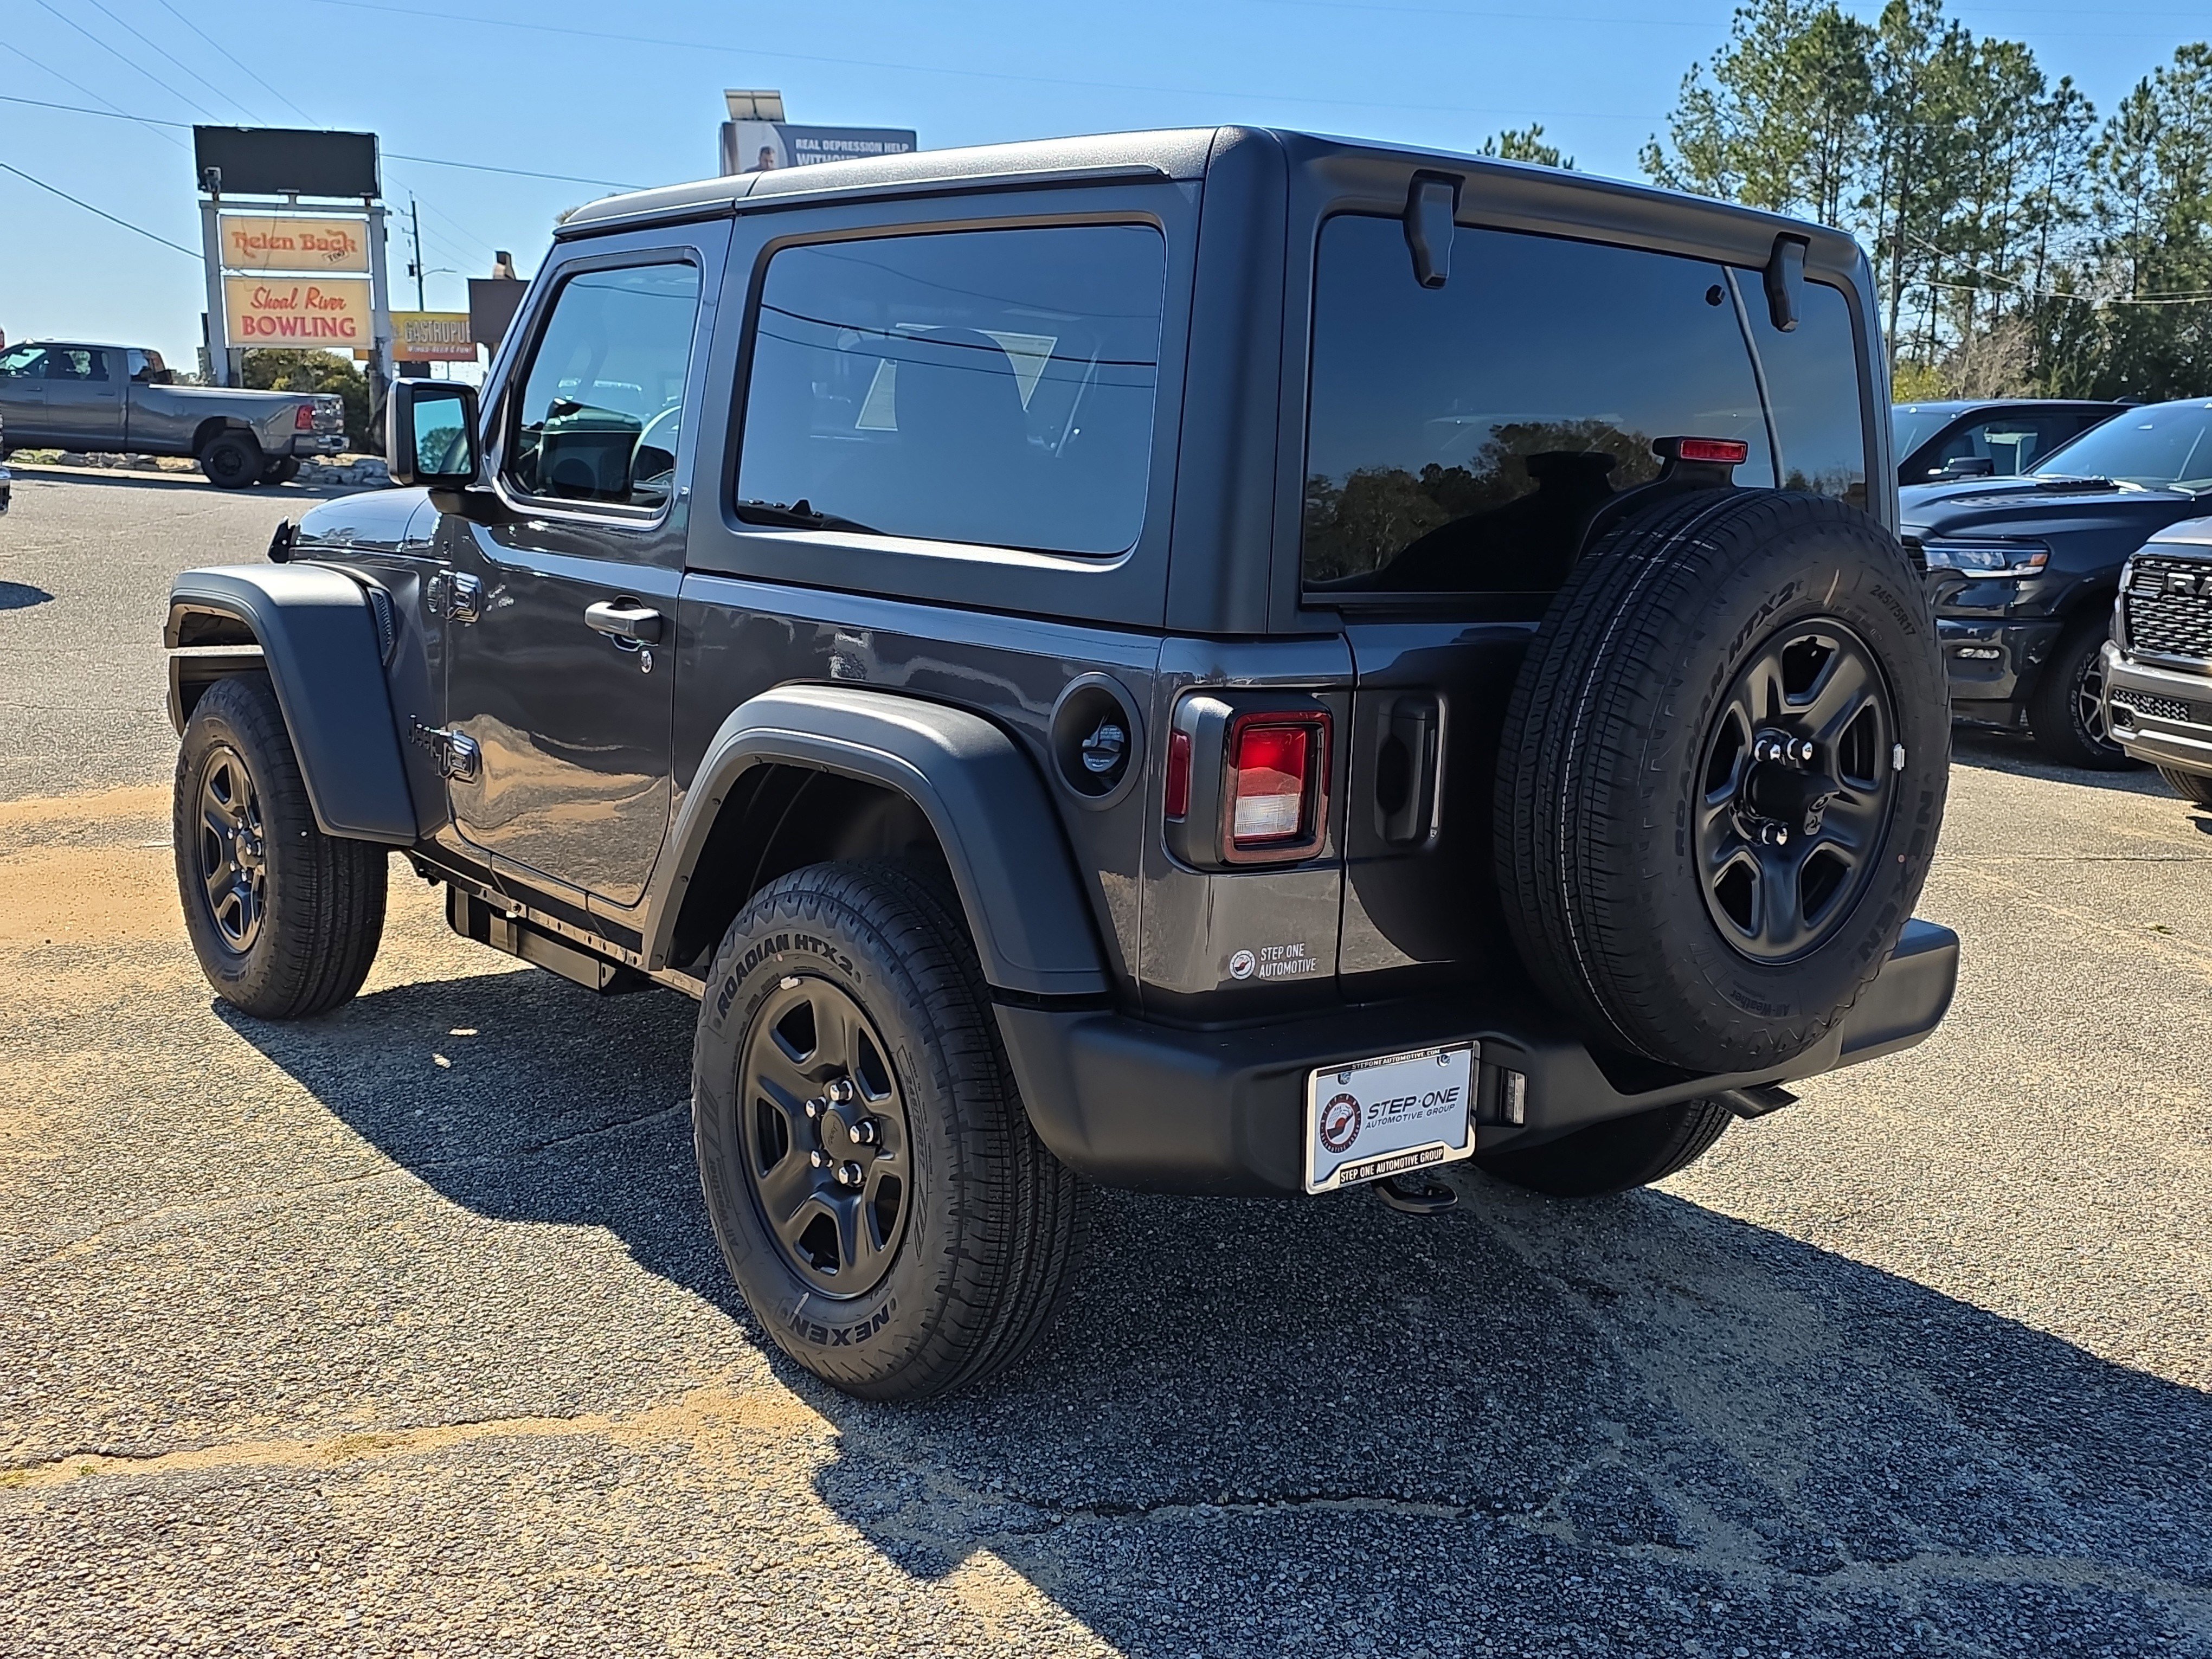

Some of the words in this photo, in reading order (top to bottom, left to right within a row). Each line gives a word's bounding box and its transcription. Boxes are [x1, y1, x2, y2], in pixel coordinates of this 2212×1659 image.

[795, 138, 820, 150] REAL
[822, 139, 883, 153] DEPRESSION
[884, 142, 909, 153] HELP
[796, 153, 858, 165] WITH
[299, 229, 358, 253] Back
[250, 286, 298, 311] Shoal
[305, 287, 346, 311] River
[242, 315, 357, 338] BOWLING
[1869, 584, 1917, 636] 245/75R17
[1260, 946, 1284, 961] STEP
[1286, 943, 1305, 958] ONE
[716, 934, 789, 1020] ROADIAN
[794, 934, 854, 977] HTX2
[1258, 957, 1317, 978] AUTOMOTIVE
[1365, 1110, 1423, 1130] AUTOMOTIVE
[1426, 1103, 1456, 1117] GROUP
[1341, 1168, 1358, 1182] STEP
[1360, 1164, 1375, 1178] ONE
[1377, 1154, 1419, 1174] AUTOMOTIVE
[1420, 1148, 1443, 1164] GROUP
[788, 1307, 891, 1347] NEXEN
